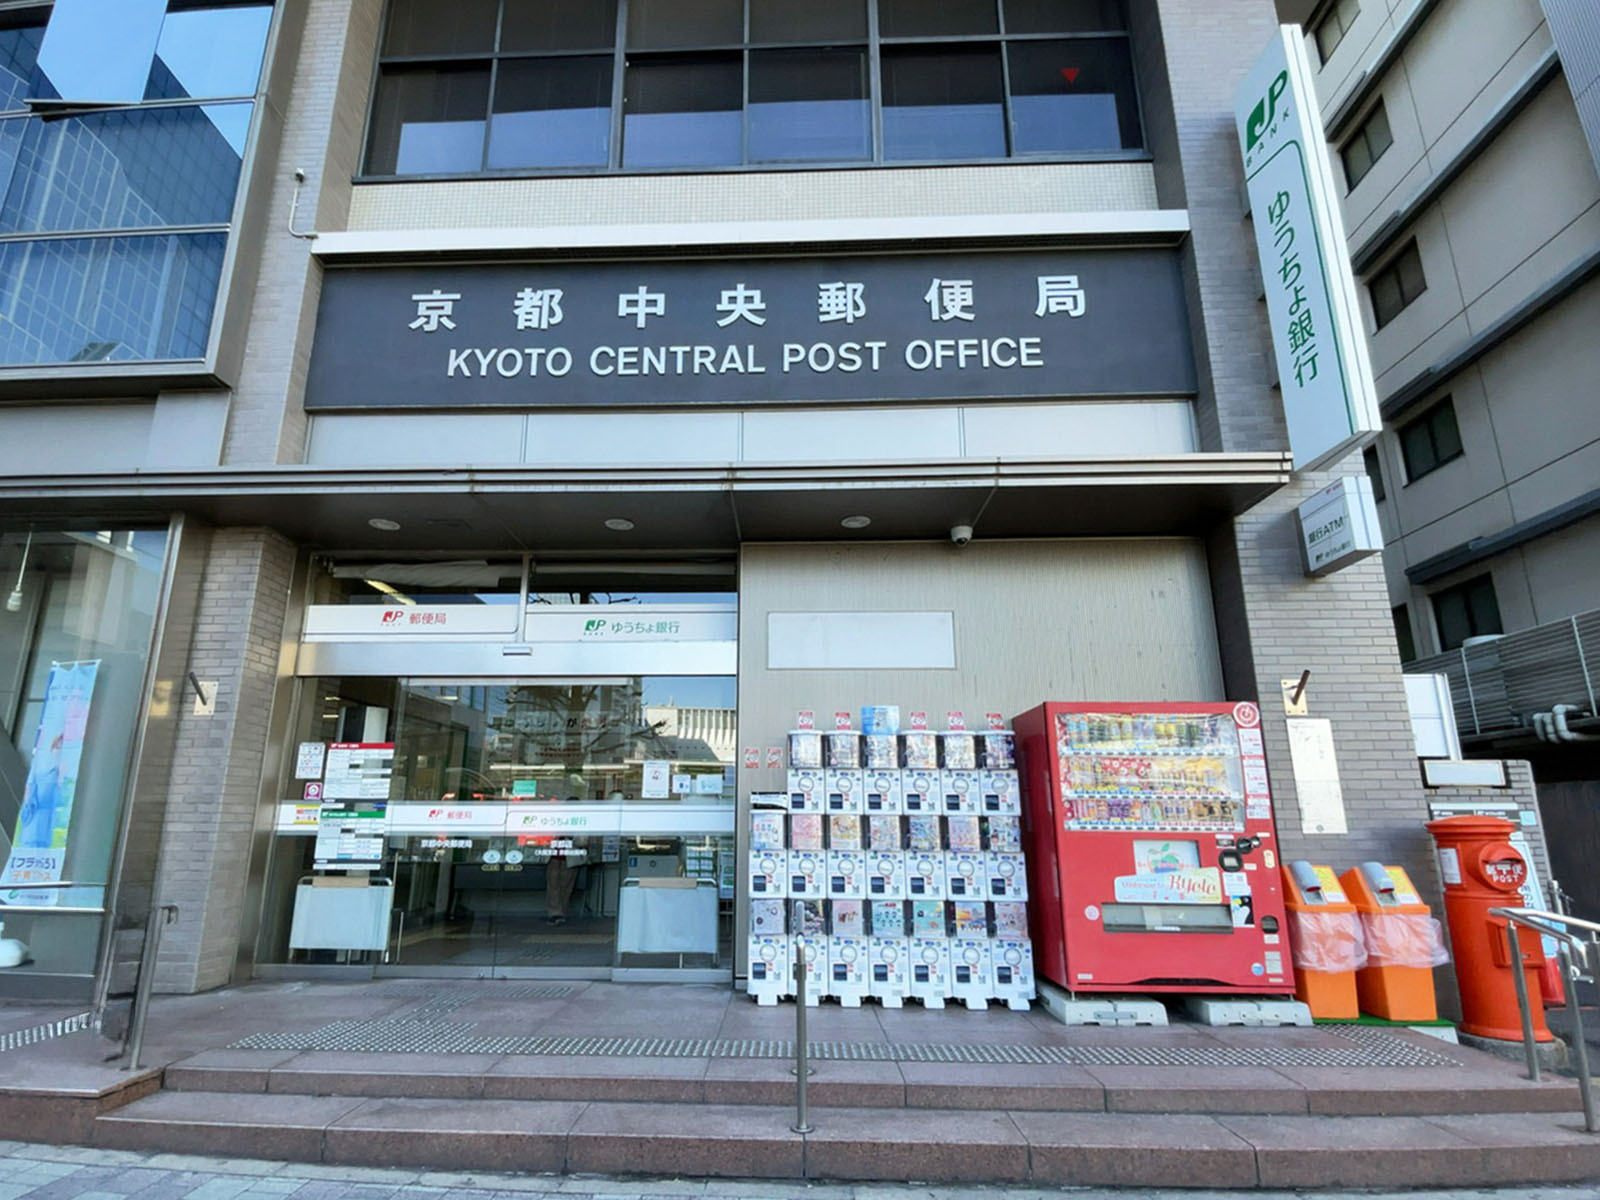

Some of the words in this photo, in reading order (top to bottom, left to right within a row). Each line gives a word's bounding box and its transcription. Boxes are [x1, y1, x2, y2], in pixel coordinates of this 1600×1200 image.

[1267, 190, 1319, 388] ゆうちょ銀行
[408, 274, 1086, 332] 京都中央郵便局
[447, 347, 573, 377] KYOTO
[589, 344, 766, 376] CENTRAL
[782, 341, 887, 373] POST
[905, 337, 1045, 370] OFFICE
[409, 612, 447, 625] 郵便局
[611, 620, 680, 634] ゆうちょ銀行
[447, 811, 473, 820] 郵便局
[541, 816, 588, 827] ゆうちょ銀行
[1493, 874, 1519, 883] POST
